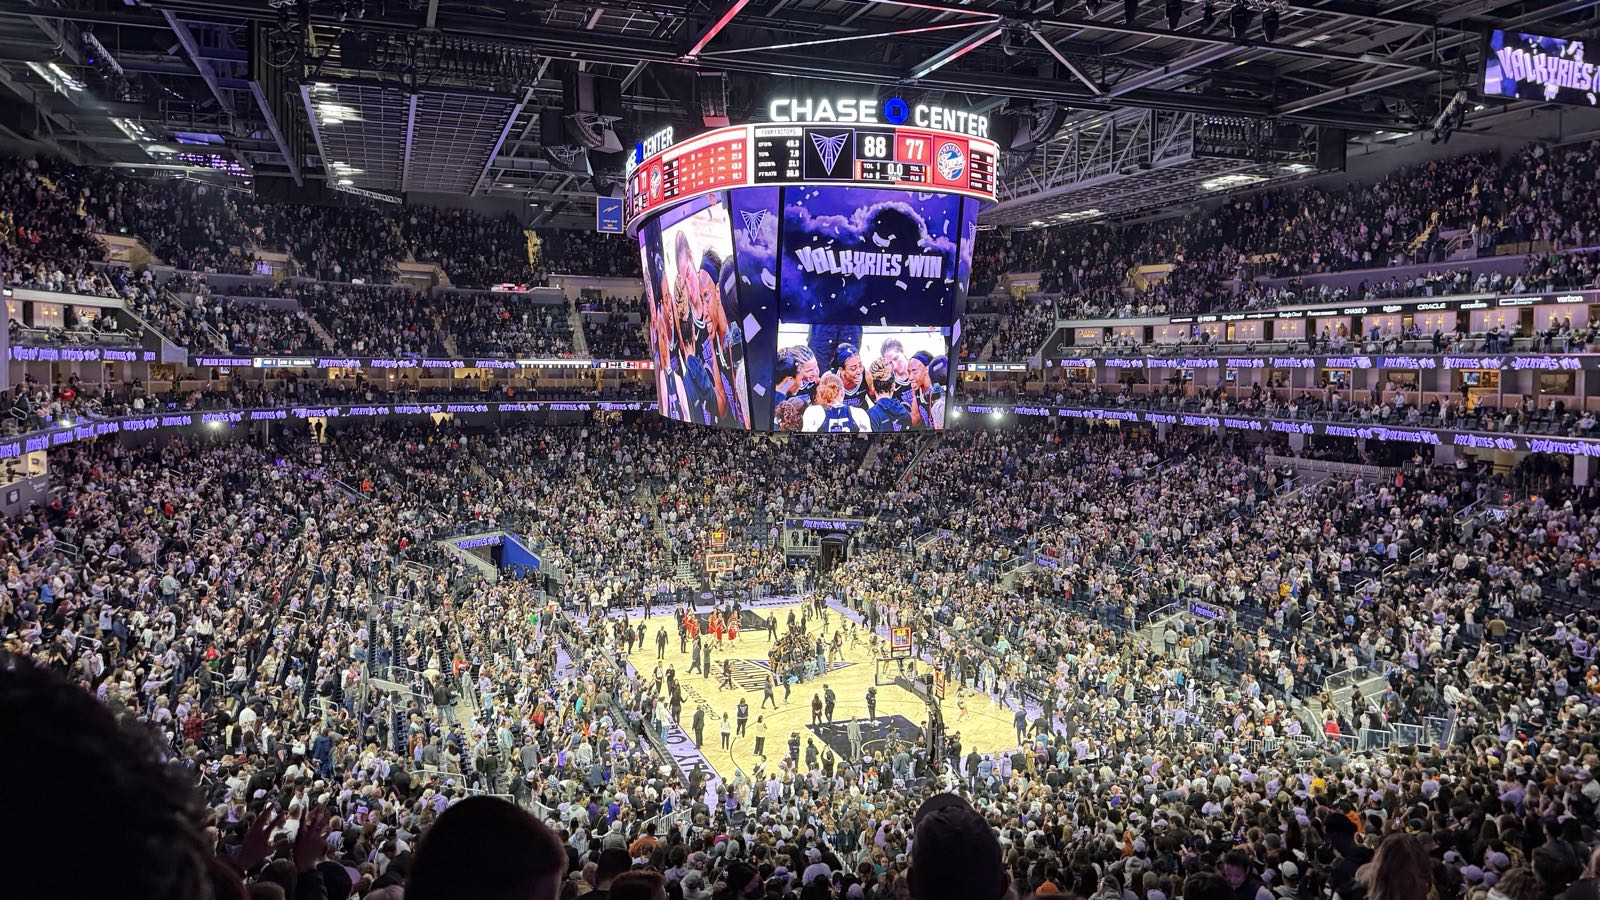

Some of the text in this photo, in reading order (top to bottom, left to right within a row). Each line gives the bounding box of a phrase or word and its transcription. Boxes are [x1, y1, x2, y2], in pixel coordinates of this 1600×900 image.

[1497, 46, 1593, 92] VALKYRIES
[770, 98, 988, 137] CHASE CENTER
[643, 126, 673, 161] CENTER
[864, 136, 887, 157] 88
[905, 138, 924, 160] 77
[888, 163, 903, 176] 0.0
[795, 246, 943, 280] VALKYRIES WIN
[1557, 295, 1583, 303] verizon
[1559, 357, 1581, 369] WIN
